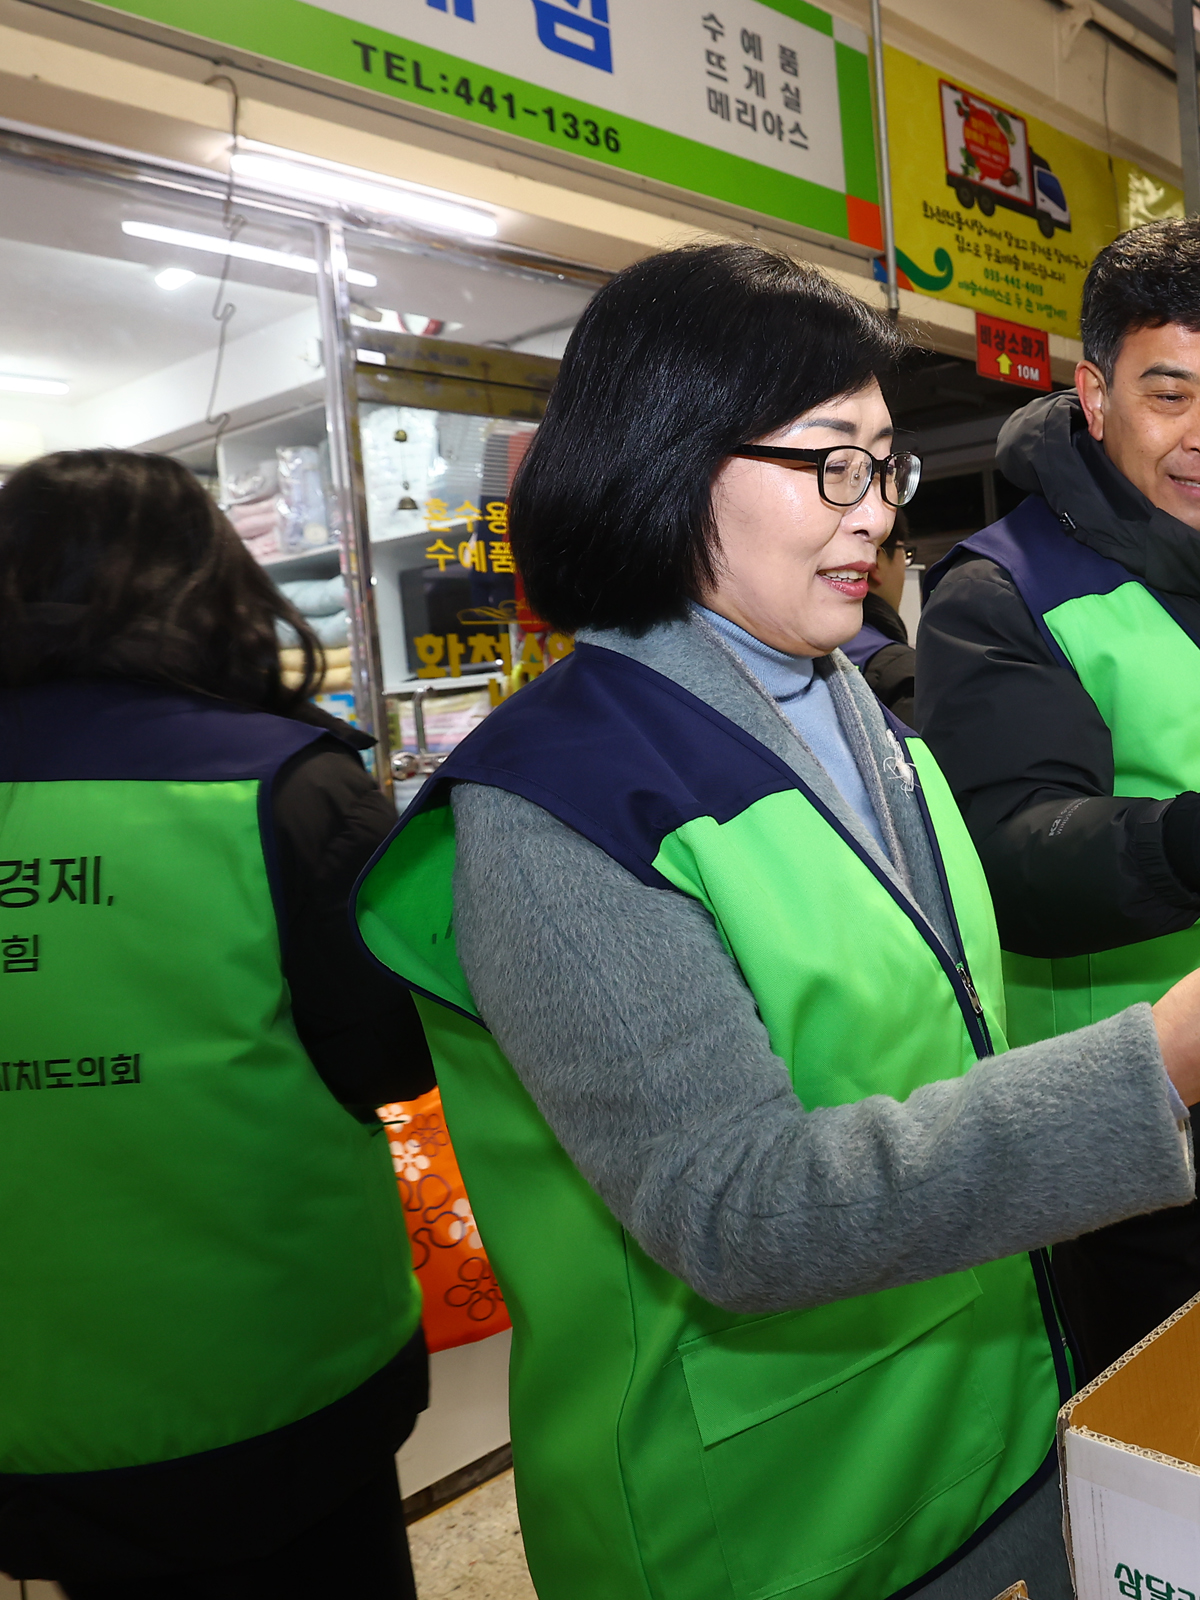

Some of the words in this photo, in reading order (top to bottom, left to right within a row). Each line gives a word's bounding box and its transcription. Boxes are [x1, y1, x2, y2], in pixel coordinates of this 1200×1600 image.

[352, 39, 621, 154] TEL:441-1336
[706, 86, 810, 151] 메리야스
[955, 233, 982, 258] 집으로
[980, 324, 1046, 363] 비상소화기
[1017, 363, 1040, 382] 10M
[424, 498, 509, 534] 혼수용
[425, 539, 516, 574] 수예품
[0, 855, 114, 909] 경제,
[1, 934, 39, 974] 힘
